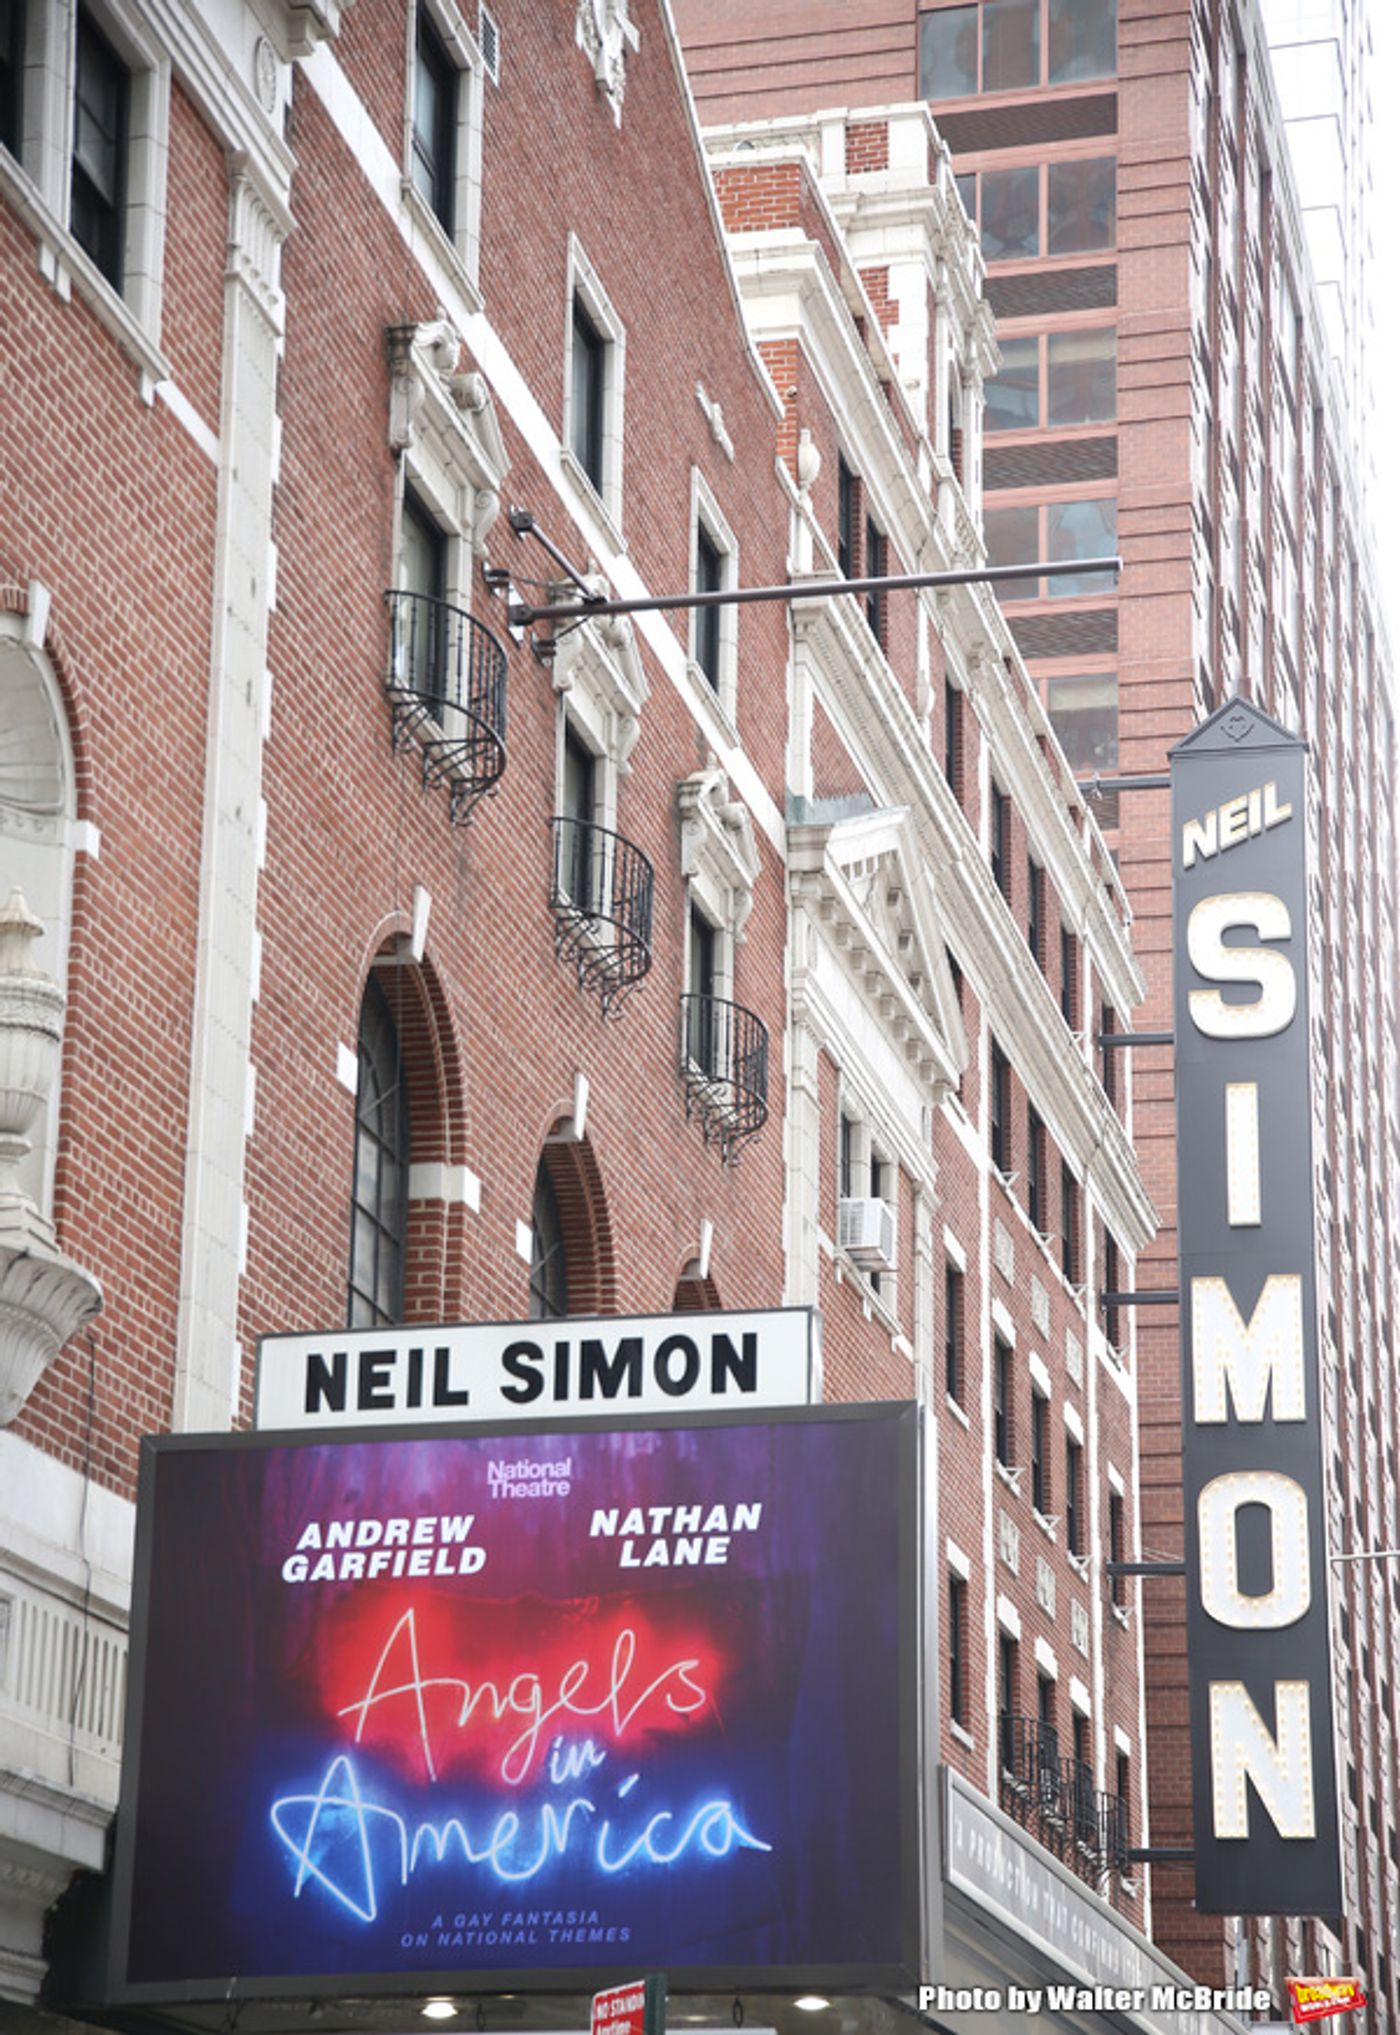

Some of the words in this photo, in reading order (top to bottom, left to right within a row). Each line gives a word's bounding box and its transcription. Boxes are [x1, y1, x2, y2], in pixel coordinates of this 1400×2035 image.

[1182, 780, 1294, 870] NEIL
[304, 1347, 469, 1414] NEIL
[500, 1332, 758, 1404] SIMON
[1187, 891, 1317, 1842] SIMON
[487, 1457, 572, 1484] National
[488, 1478, 571, 1500] Theatre
[296, 1515, 475, 1550] ANDREW
[589, 1503, 763, 1537] NATHAN
[281, 1546, 487, 1583] GARFIELD
[618, 1536, 731, 1568] LANE
[338, 1607, 706, 1785] Angels
[549, 1735, 606, 1784] in
[270, 1755, 773, 1923] America
[401, 1933, 428, 1947] ON
[438, 1929, 538, 1946] NATIONAL
[550, 1927, 631, 1943] THEMES
[431, 1915, 443, 1929] A
[454, 1913, 493, 1928] GAY
[501, 1910, 600, 1926] FANTASIA
